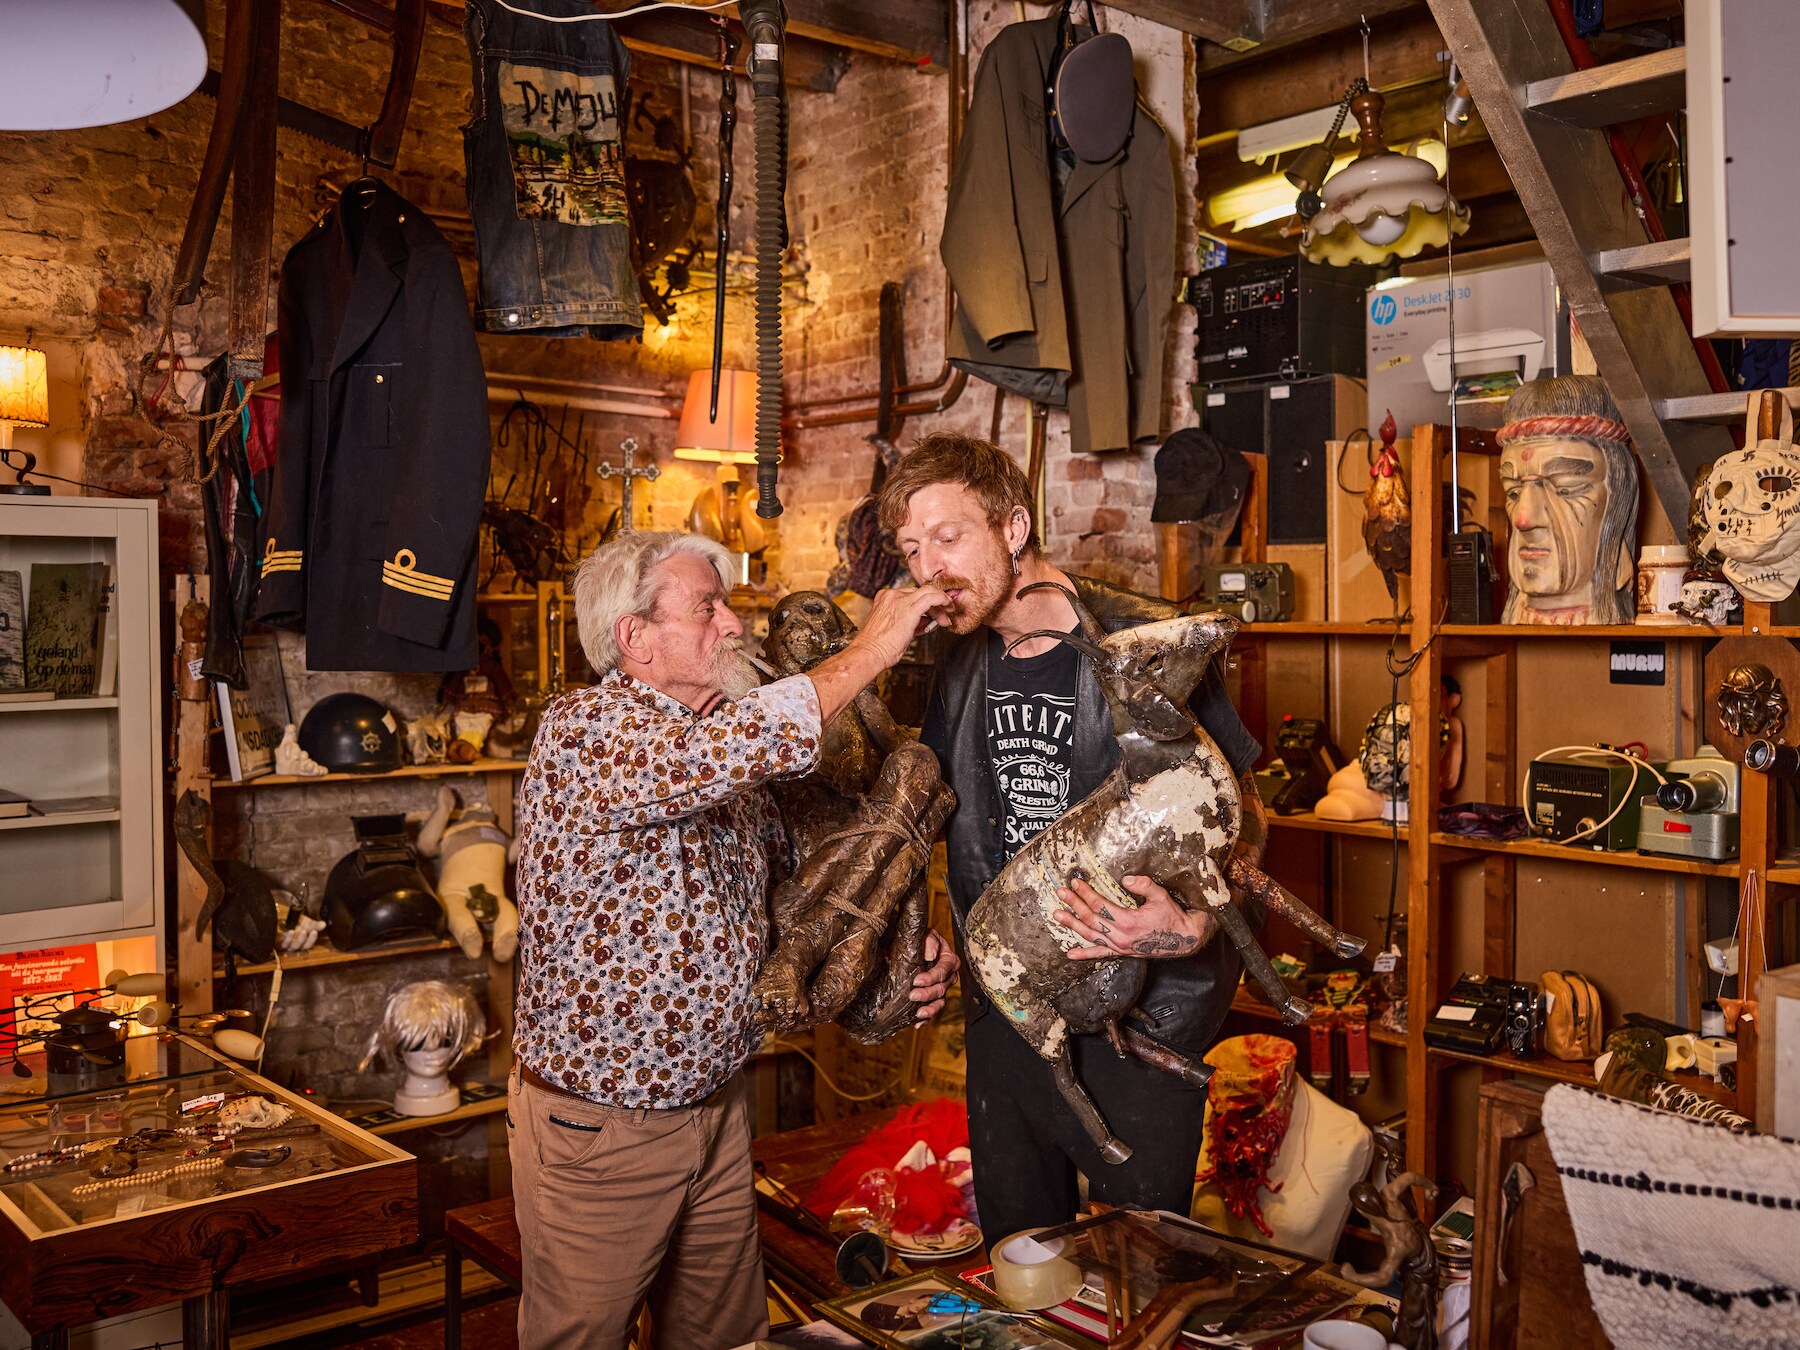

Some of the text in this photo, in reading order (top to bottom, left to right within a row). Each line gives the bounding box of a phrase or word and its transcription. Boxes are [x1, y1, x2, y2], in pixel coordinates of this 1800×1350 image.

[1403, 292, 1442, 308] DeskJet
[1374, 295, 1395, 325] hp
[1403, 306, 1447, 318] Everyday printing
[1610, 653, 1664, 672] MURW
[36, 663, 53, 680] op
[988, 704, 1073, 746] ITEAT
[997, 738, 1030, 751] DEATH
[1019, 764, 1045, 779] 66,6
